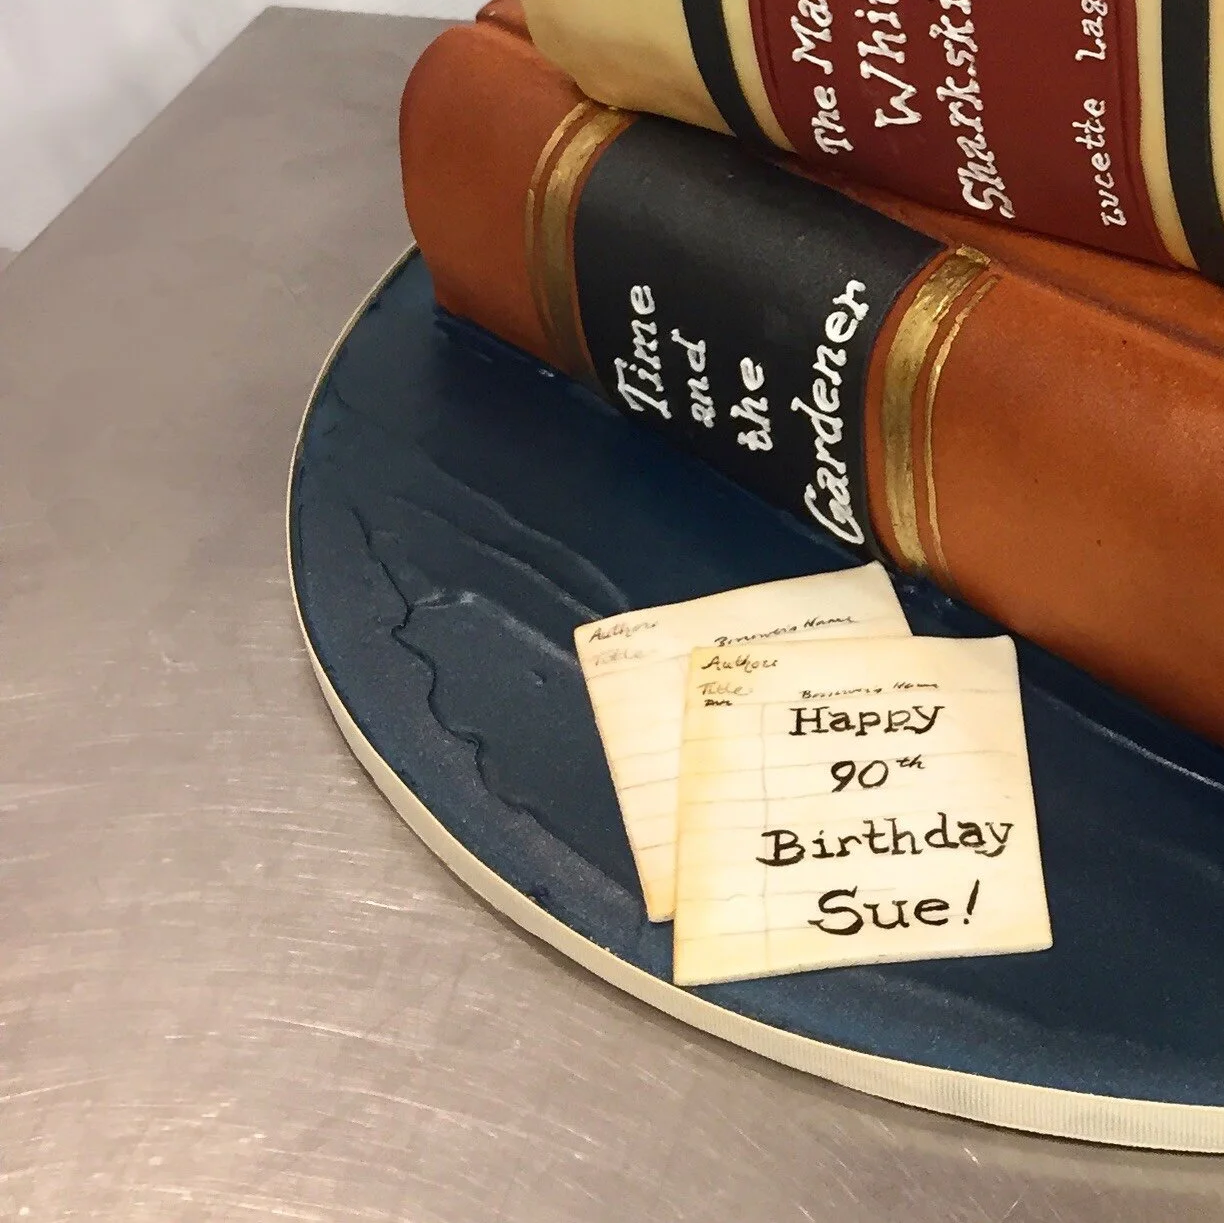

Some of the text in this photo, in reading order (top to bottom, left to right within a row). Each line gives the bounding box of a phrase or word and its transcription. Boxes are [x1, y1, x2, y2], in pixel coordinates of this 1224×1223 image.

[811, 85, 854, 154] The
[613, 285, 672, 420] Time
[670, 328, 716, 428] and
[729, 356, 774, 451] the
[790, 279, 870, 545] Gardener
[788, 704, 945, 738] Happy
[829, 753, 926, 794] 90th
[755, 811, 1015, 868] Birthday
[807, 878, 981, 937] Sue!
